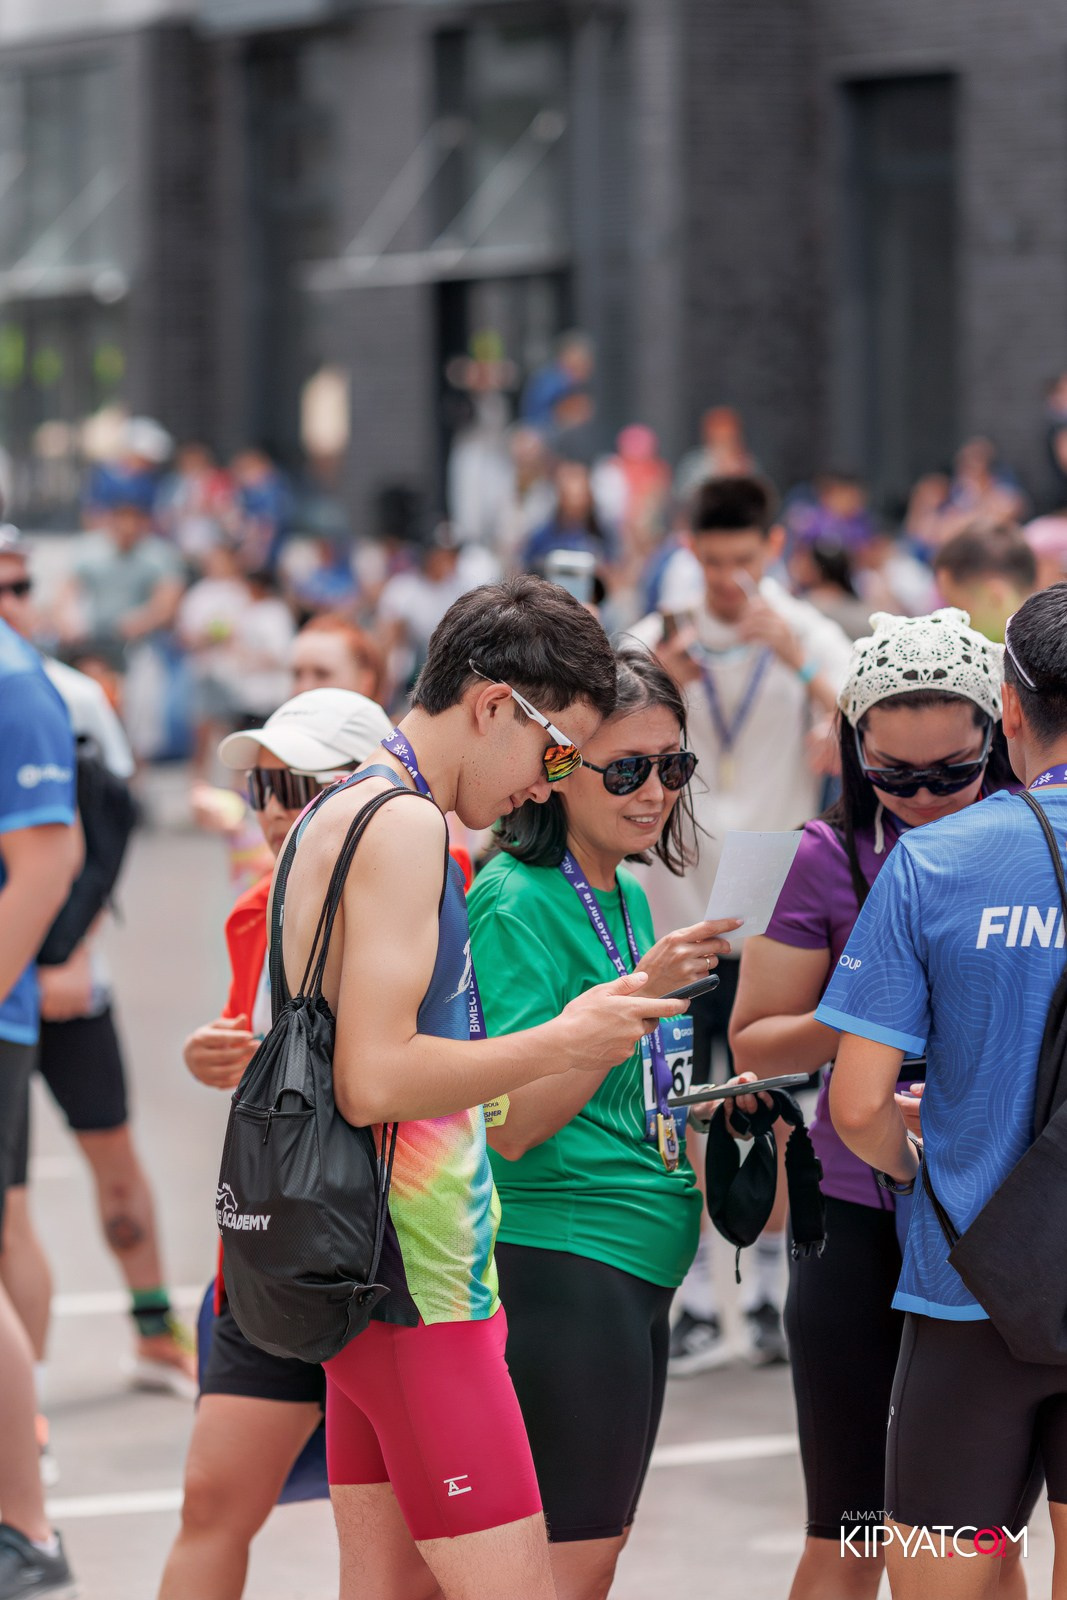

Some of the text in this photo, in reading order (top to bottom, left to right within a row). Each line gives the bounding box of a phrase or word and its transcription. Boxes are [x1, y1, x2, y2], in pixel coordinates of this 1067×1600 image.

[583, 892, 614, 951] BI JULDYZAI
[222, 1211, 271, 1231] ACADEMY
